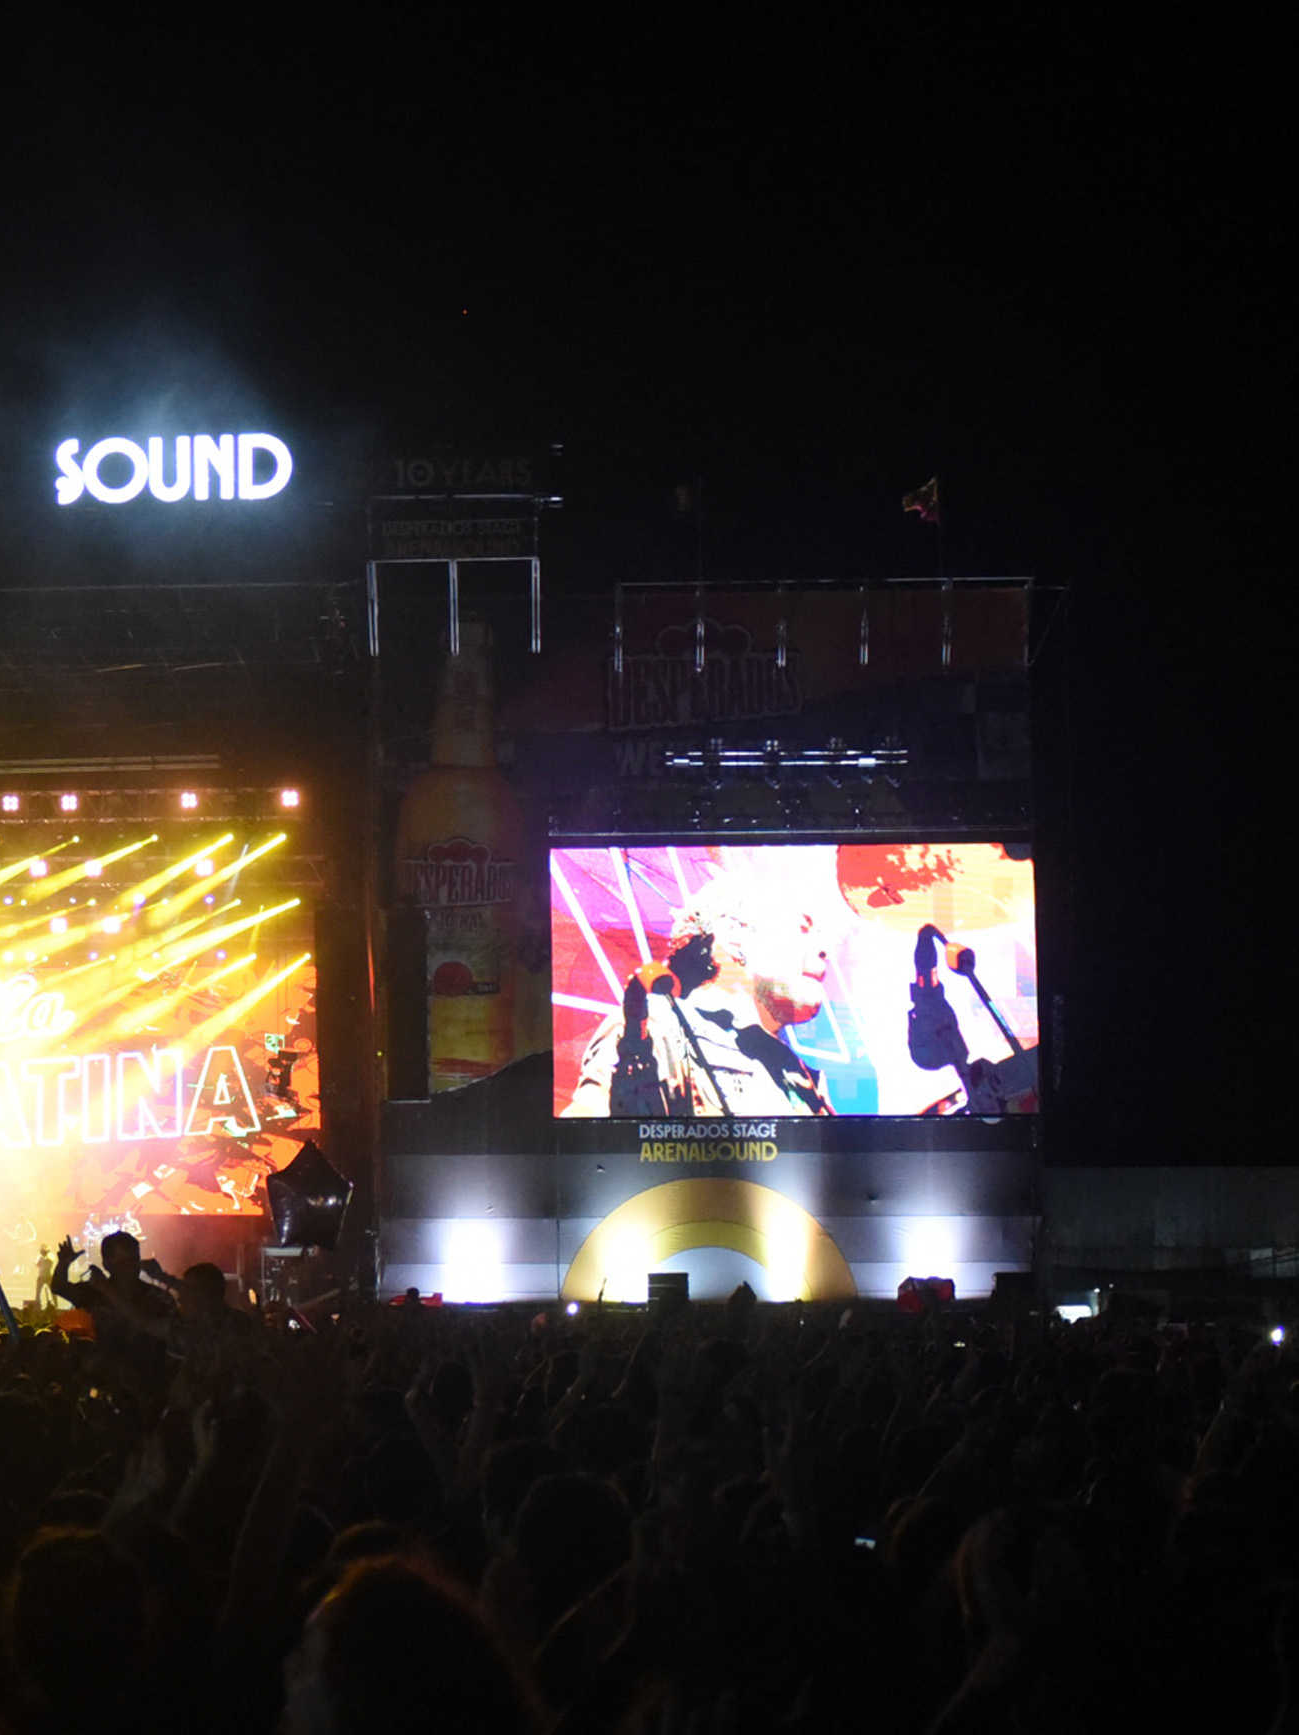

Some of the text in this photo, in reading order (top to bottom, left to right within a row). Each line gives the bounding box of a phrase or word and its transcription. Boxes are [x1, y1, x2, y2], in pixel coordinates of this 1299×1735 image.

[55, 432, 294, 506] SOUND
[639, 1122, 778, 1140] DESPERADOS STAGE
[639, 1140, 779, 1163] ARENALSOUND
